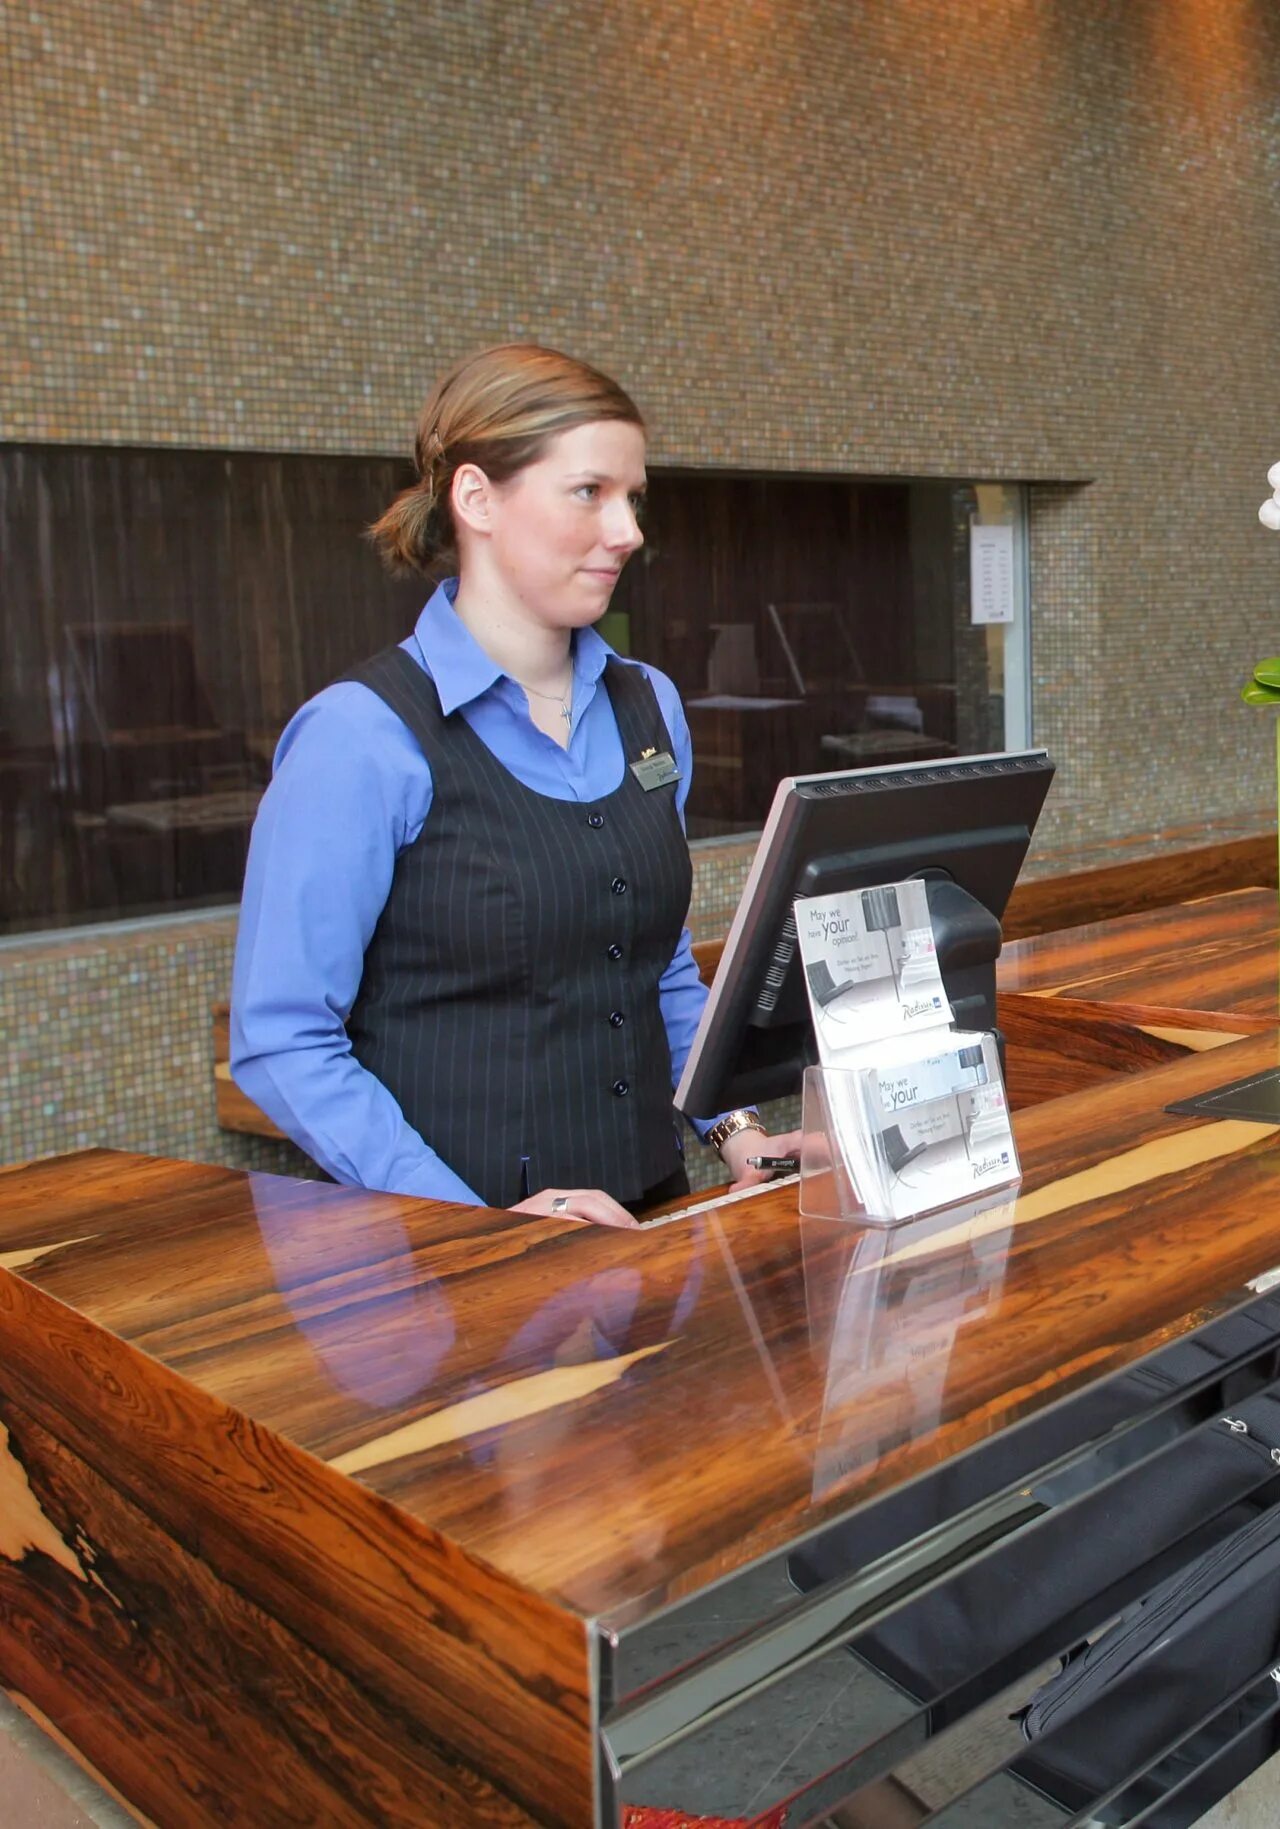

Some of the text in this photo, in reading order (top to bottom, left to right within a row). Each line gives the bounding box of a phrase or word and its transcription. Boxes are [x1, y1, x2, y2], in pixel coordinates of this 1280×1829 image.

[810, 908, 841, 922] May we
[822, 918, 850, 942] your
[879, 1078, 909, 1093] May we
[891, 1086, 918, 1111] your
